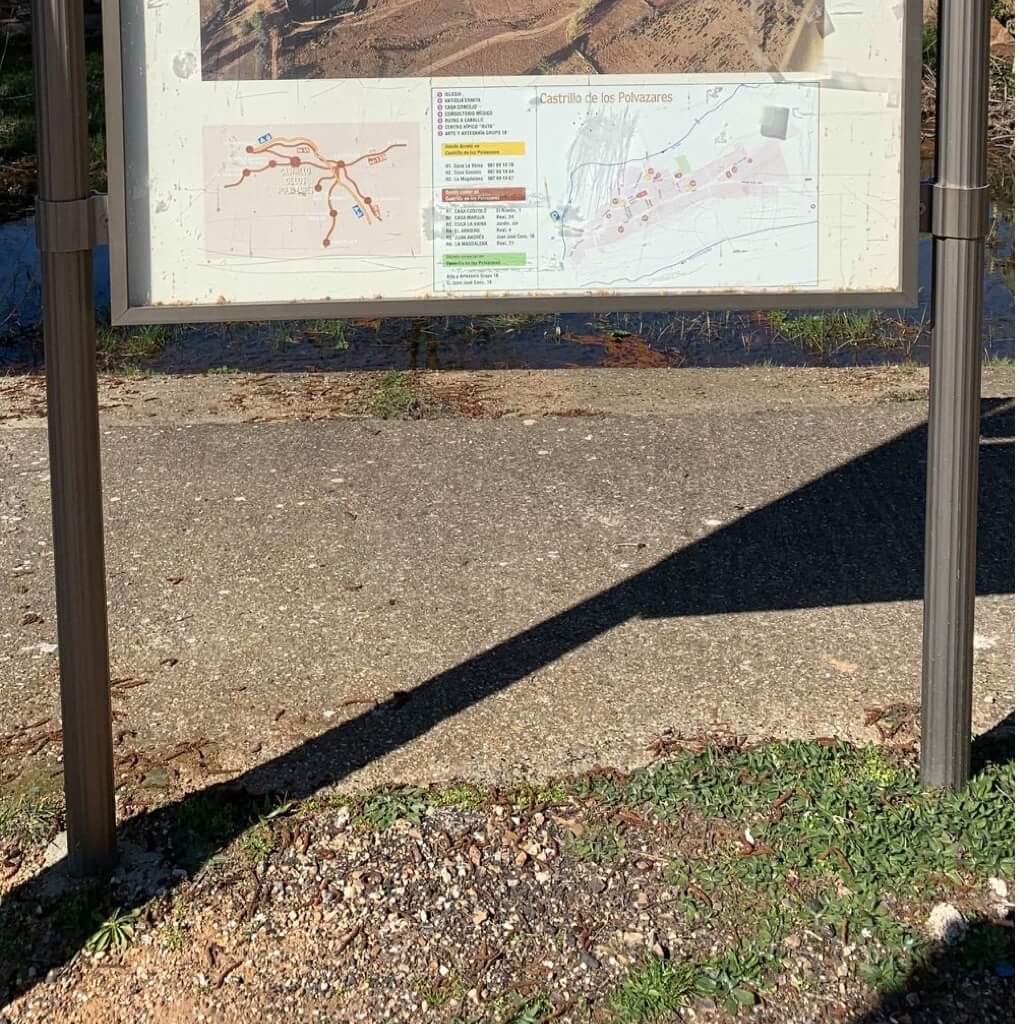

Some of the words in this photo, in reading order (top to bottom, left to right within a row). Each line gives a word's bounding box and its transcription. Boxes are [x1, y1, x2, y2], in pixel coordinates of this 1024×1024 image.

[540, 92, 582, 104] Castrillo
[585, 92, 599, 104] de
[600, 92, 616, 104] los
[618, 91, 673, 104] Polvazares
